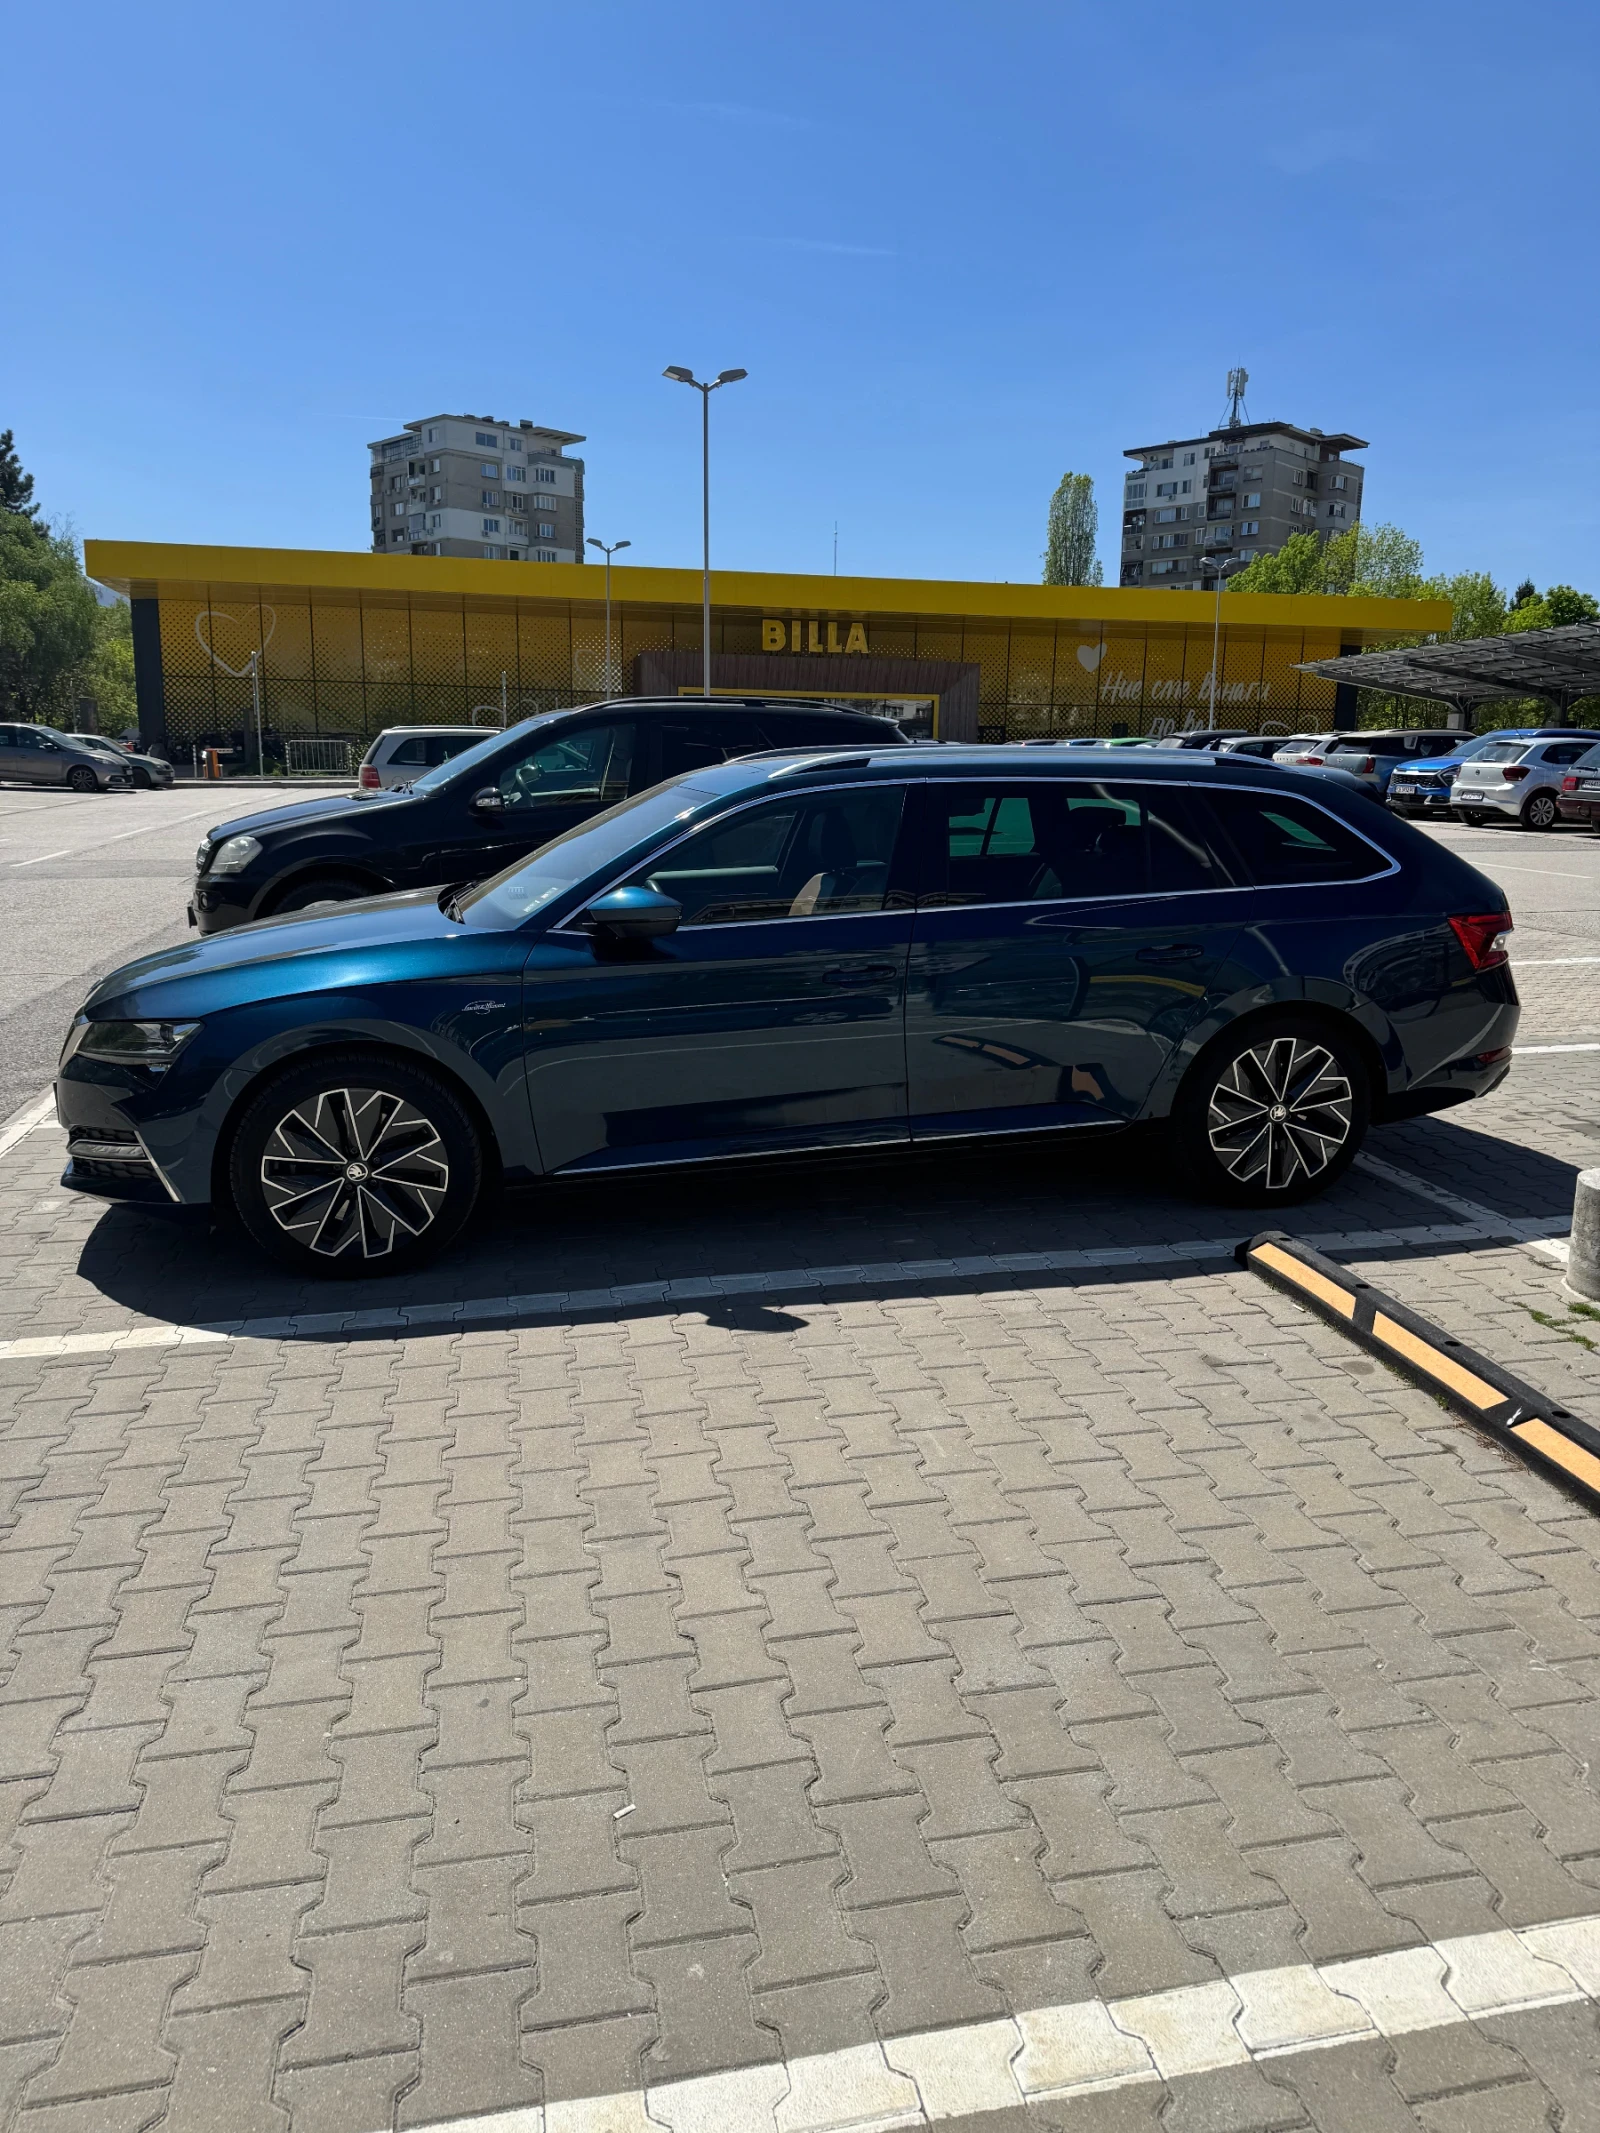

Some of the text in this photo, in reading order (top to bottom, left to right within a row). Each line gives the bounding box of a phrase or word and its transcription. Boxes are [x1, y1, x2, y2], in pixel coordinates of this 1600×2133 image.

[762, 619, 869, 654] BILLA
[1100, 670, 1142, 705] Ние
[1151, 679, 1191, 701] сме
